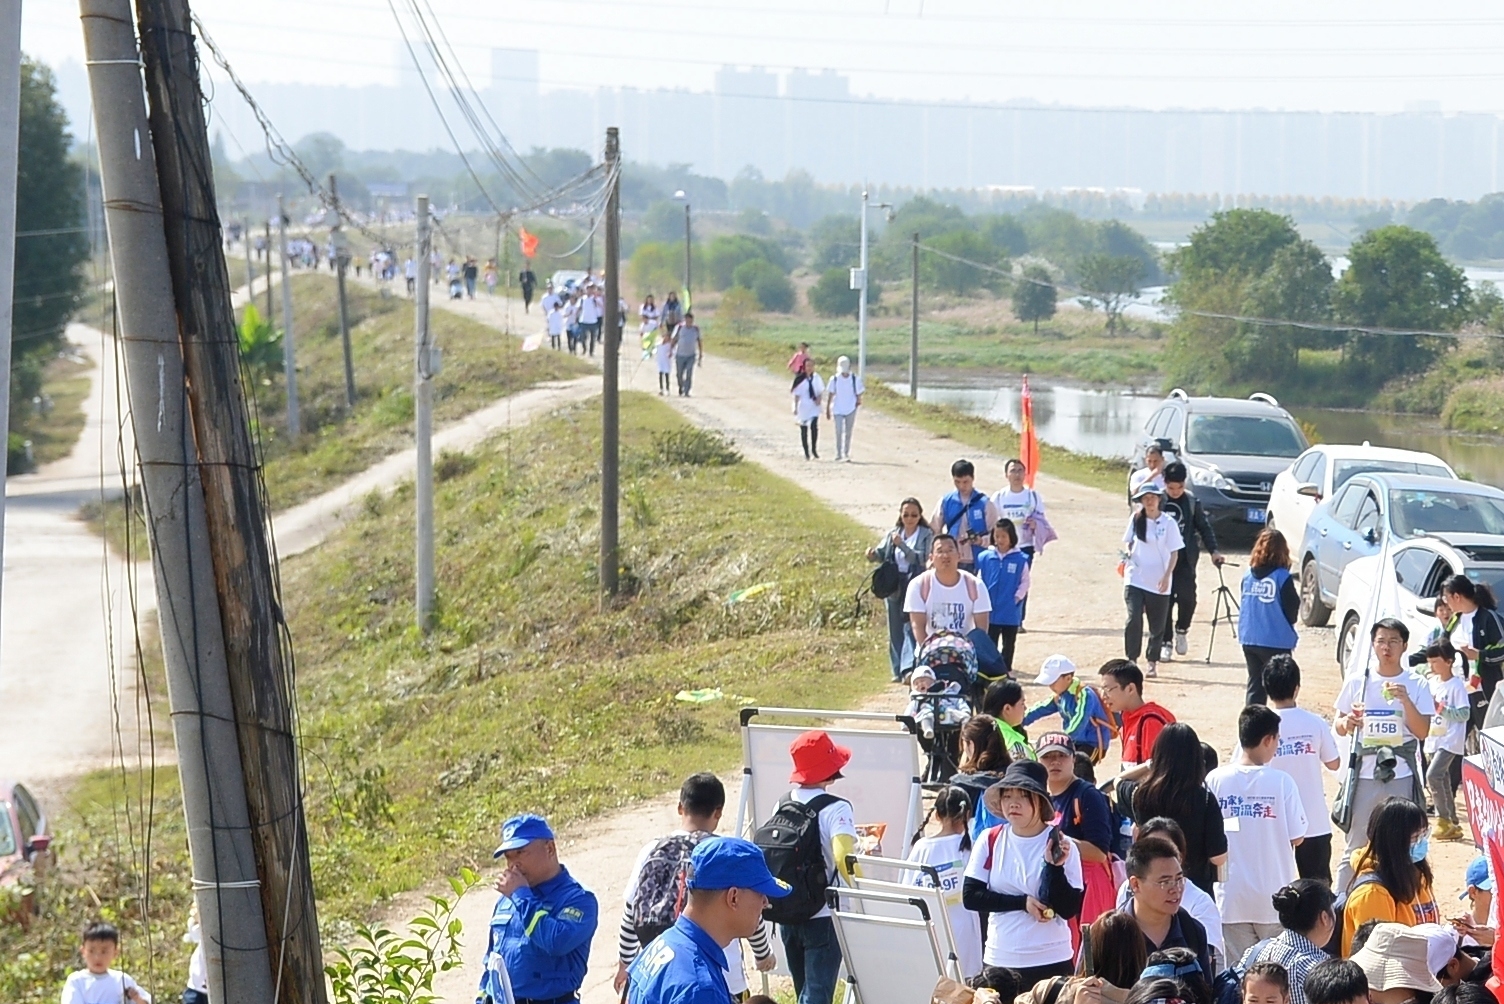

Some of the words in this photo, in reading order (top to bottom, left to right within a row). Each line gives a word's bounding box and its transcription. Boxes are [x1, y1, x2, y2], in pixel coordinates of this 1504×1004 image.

[1369, 723, 1397, 734] 115B
[1230, 803, 1276, 818] 河流奔走
